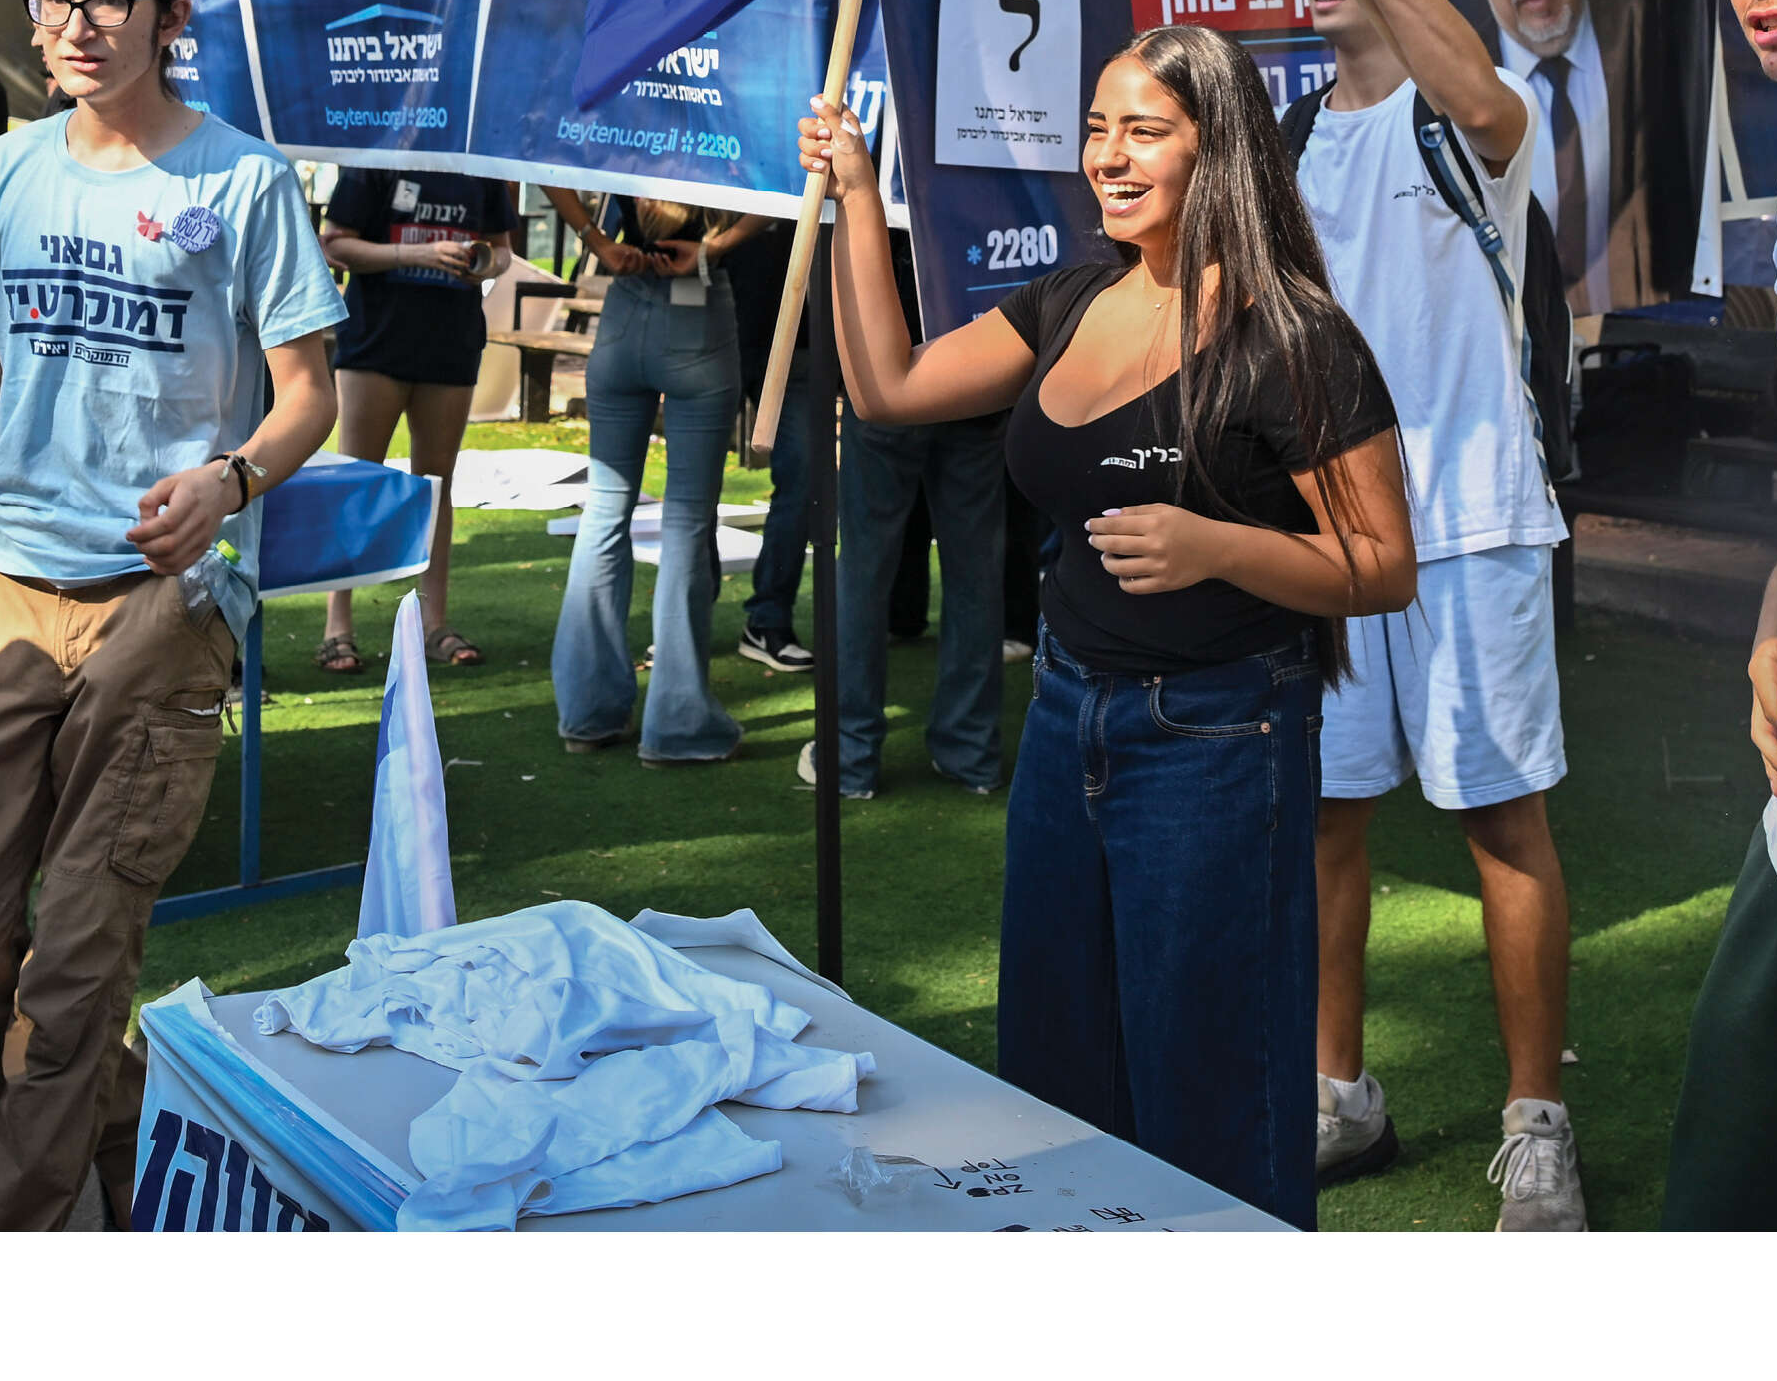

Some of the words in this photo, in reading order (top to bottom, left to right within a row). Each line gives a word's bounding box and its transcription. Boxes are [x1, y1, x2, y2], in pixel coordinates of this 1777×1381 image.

[327, 35, 383, 61] ביתנו
[384, 31, 443, 60] ישראל
[330, 67, 365, 86] ליברמן
[367, 68, 411, 83] אביגדור
[633, 80, 678, 100] אביגדור
[679, 86, 723, 106] בראשות
[415, 106, 448, 129] 2280
[975, 106, 1006, 120] ביתנו
[1009, 105, 1047, 123] ישראל
[557, 117, 679, 155] beytenu.org.il
[696, 131, 741, 160] 2280
[957, 125, 988, 140] ליברמן
[987, 224, 1058, 270] 2280
